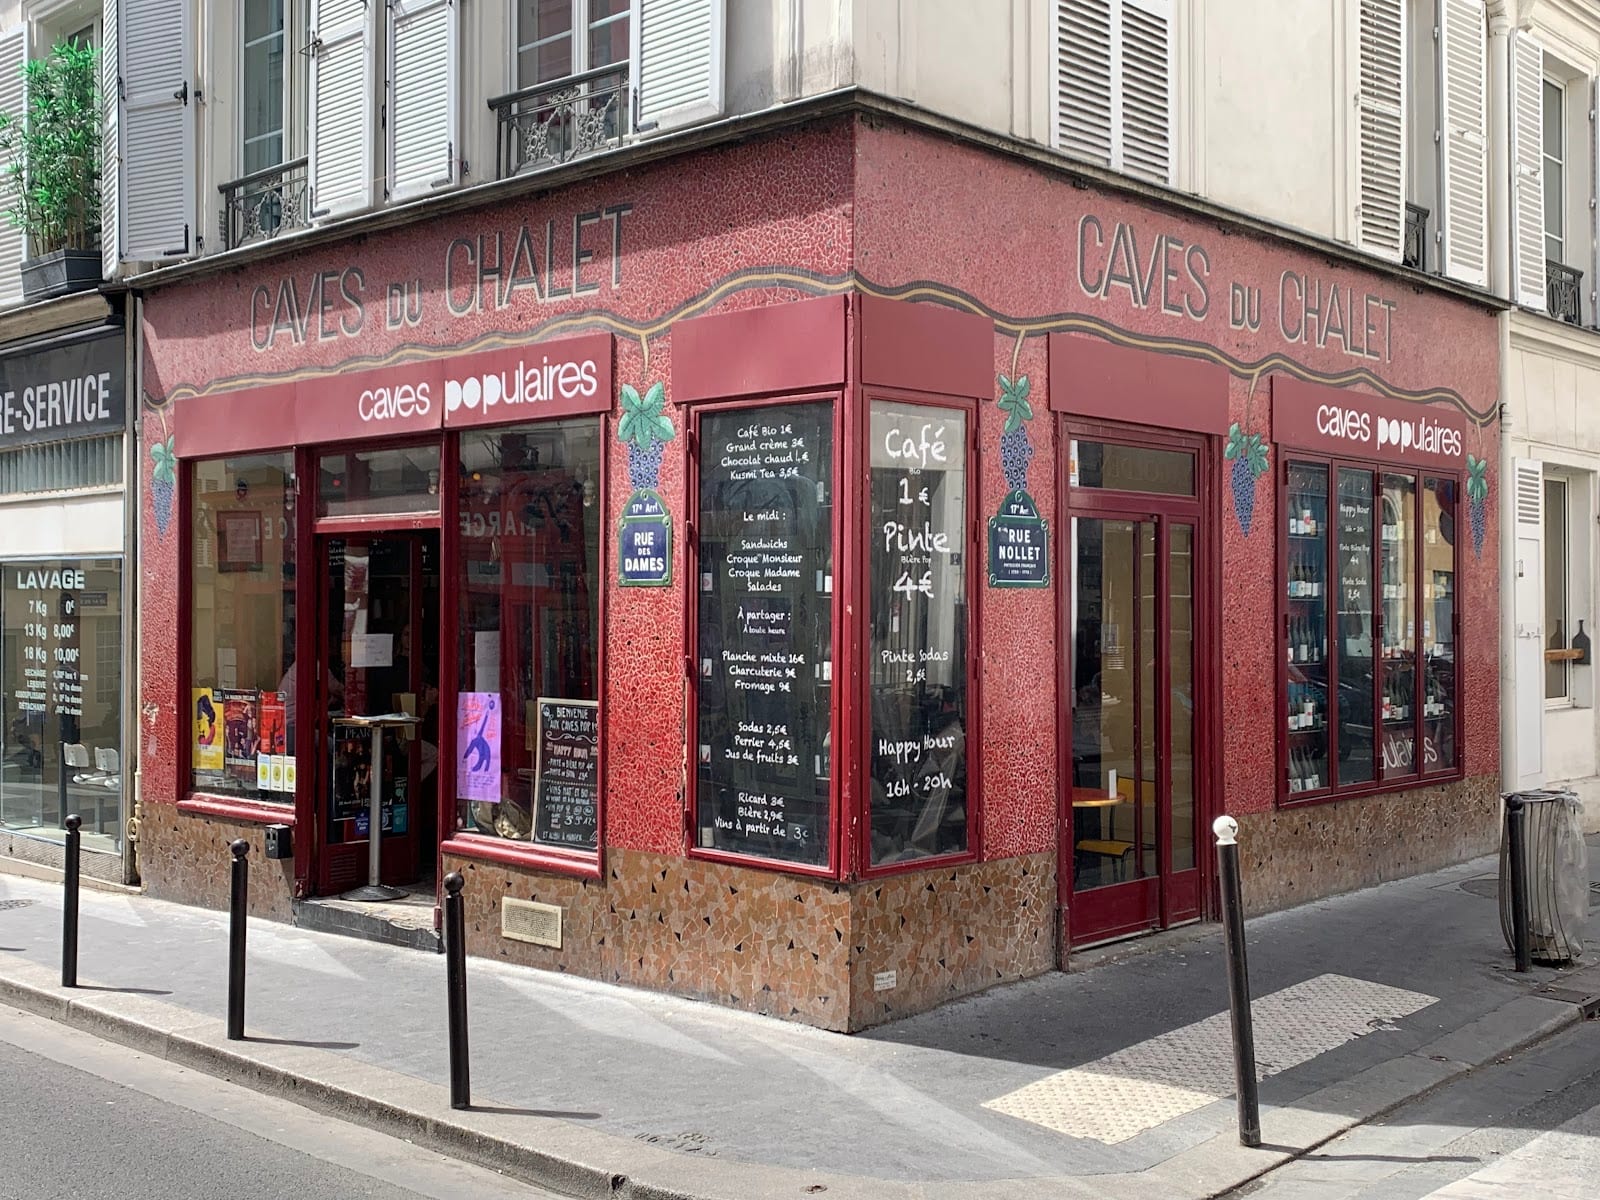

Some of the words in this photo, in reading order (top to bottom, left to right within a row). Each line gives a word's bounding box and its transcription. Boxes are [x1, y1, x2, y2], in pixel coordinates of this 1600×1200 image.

[250, 266, 366, 353] CAVES
[386, 277, 424, 331] DU
[444, 203, 633, 318] CHALET
[1077, 213, 1211, 322] CAVES
[1229, 281, 1261, 333] DU
[1278, 270, 1397, 364] CHALET
[358, 381, 430, 422] caves
[443, 355, 597, 420] populaires
[0, 372, 111, 435] E-SERVICE
[737, 424, 759, 439] Café
[762, 425, 777, 436] Bio
[780, 424, 793, 434] 1€
[1316, 404, 1370, 443] caves
[1376, 414, 1462, 457] populaires
[726, 440, 757, 453] Grand
[759, 438, 788, 450] crème
[791, 437, 805, 448] 3€
[885, 423, 946, 468] Café
[721, 455, 761, 467] Chocolat
[764, 451, 793, 464] chaud
[730, 469, 758, 480] Kusmi
[759, 468, 775, 478] Tea
[899, 477, 913, 505] 1
[743, 511, 754, 521] Le
[757, 508, 779, 521] midi
[634, 532, 654, 546] RUE
[883, 520, 950, 552] Pinte
[1009, 528, 1031, 543] RUE
[638, 547, 651, 555] DES
[741, 538, 788, 550] Sandwichs
[998, 545, 1040, 560] NOLLET
[625, 557, 664, 571] DAMES
[726, 554, 759, 568] Croque
[762, 553, 803, 563] Monsieur
[17, 569, 85, 589] LAVAGE
[728, 568, 761, 582] Croque
[764, 567, 800, 578] Madame
[747, 582, 782, 592] Salades
[892, 570, 934, 600] 4€
[29, 600, 34, 614] 7
[36, 600, 47, 617] Kg
[746, 609, 785, 624] partager
[24, 623, 34, 637] 13
[36, 623, 47, 640] Kg
[36, 646, 47, 663] Kg
[722, 650, 757, 662] Planche
[761, 652, 786, 664] mixte
[788, 653, 805, 664] 16€
[881, 650, 916, 663] Pinte
[729, 665, 782, 678] Charcuterie
[785, 667, 796, 679] 9€
[734, 680, 775, 694] Fromage
[779, 681, 791, 693] 9€
[738, 721, 763, 733] Sodas
[734, 735, 764, 746] Perrier
[879, 738, 921, 764] Happy
[923, 735, 955, 751] Hour
[725, 749, 740, 759] Jus
[743, 750, 754, 761] de
[756, 750, 784, 764] fruits
[786, 755, 800, 766] 3€
[886, 778, 910, 798] 16h
[923, 773, 952, 791] 20h
[738, 792, 767, 806] Ricard
[770, 797, 785, 807] 3€
[737, 806, 762, 820] Bière
[763, 809, 784, 822] 2,9€
[715, 816, 733, 829] Vins
[745, 823, 770, 837] partir
[772, 825, 786, 837] de
